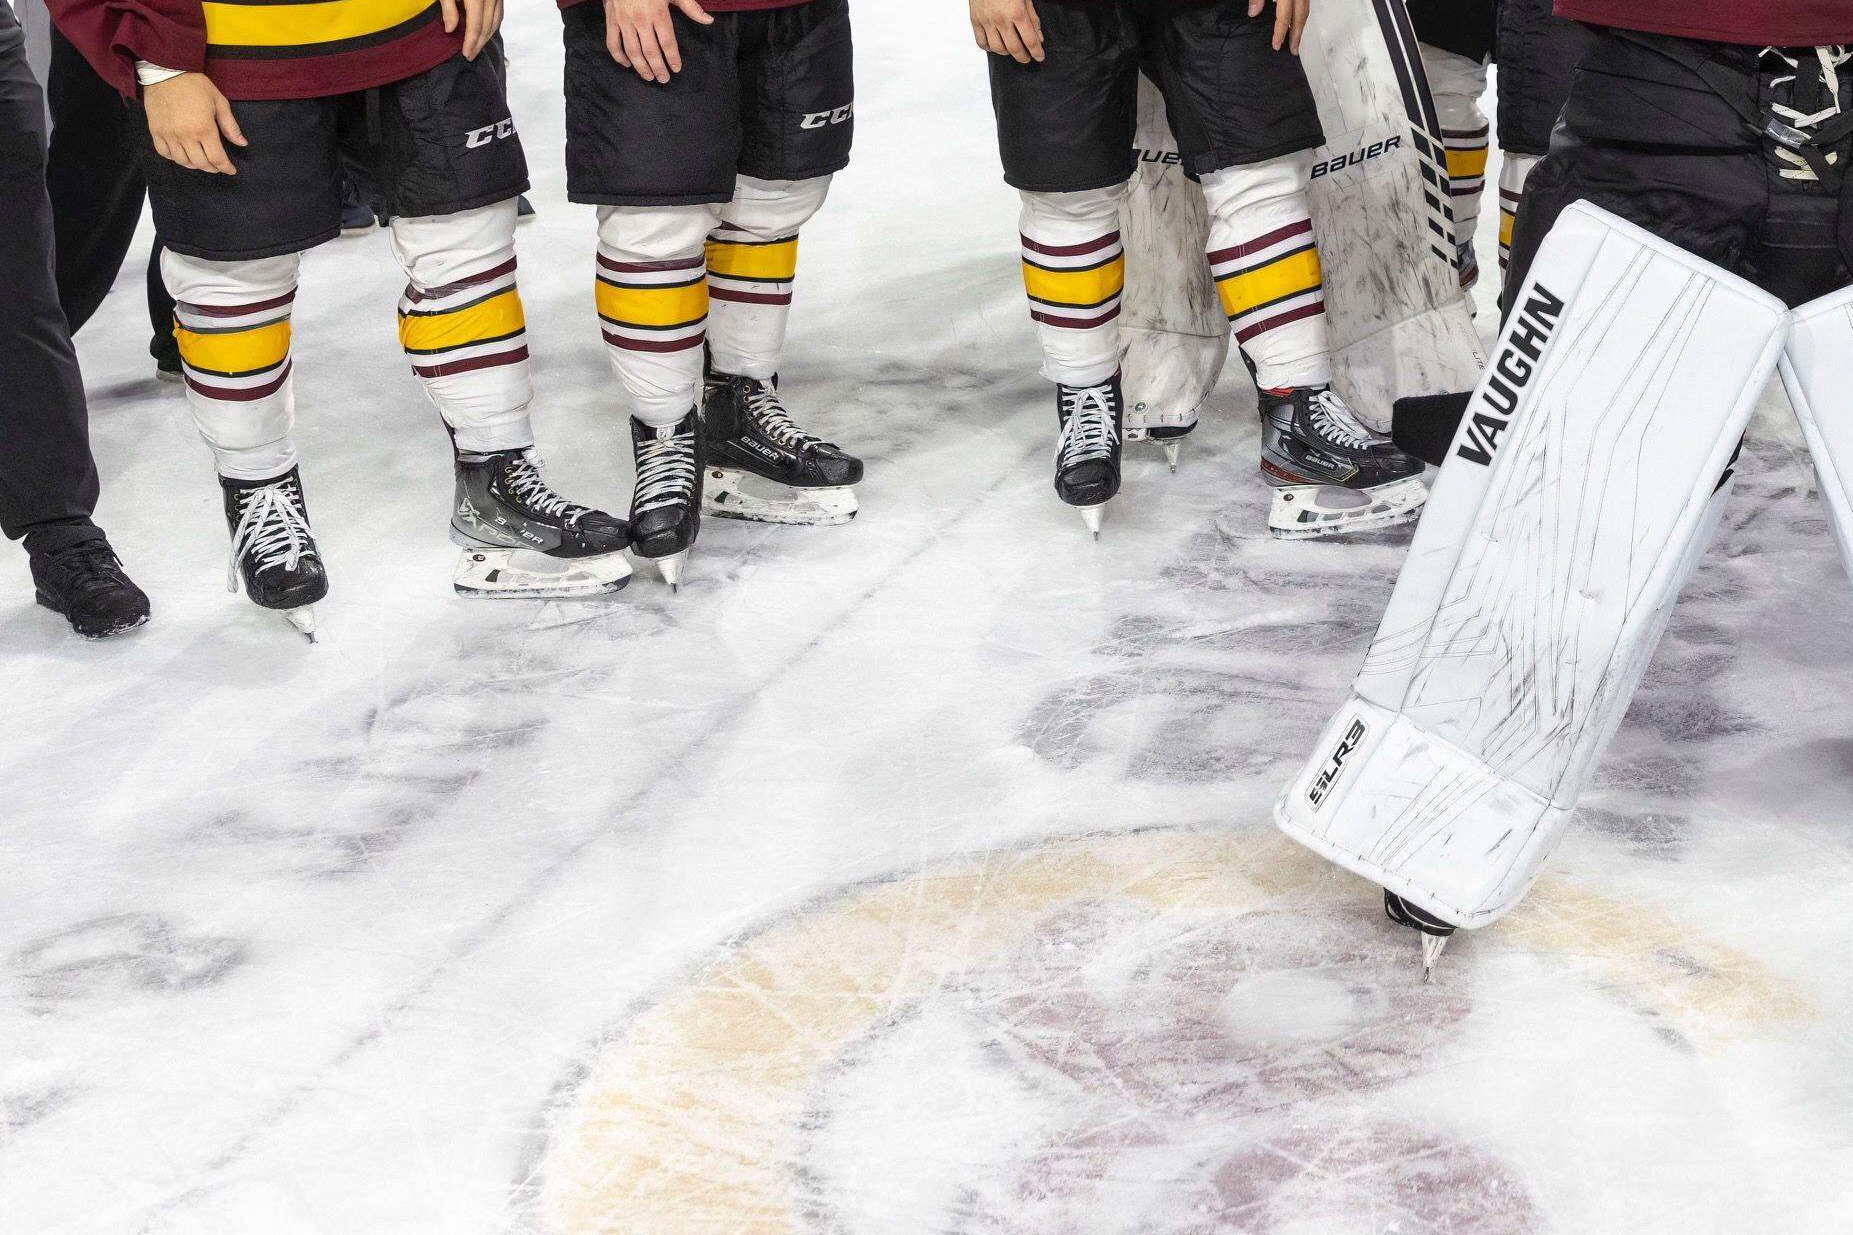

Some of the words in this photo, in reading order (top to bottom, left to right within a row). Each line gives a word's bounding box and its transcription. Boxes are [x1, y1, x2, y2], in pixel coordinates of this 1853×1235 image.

[800, 101, 854, 130] CC
[464, 116, 518, 149] CC
[1310, 134, 1401, 180] BAUER
[1456, 281, 1566, 467] VAUGHN
[740, 435, 779, 462] BAUER
